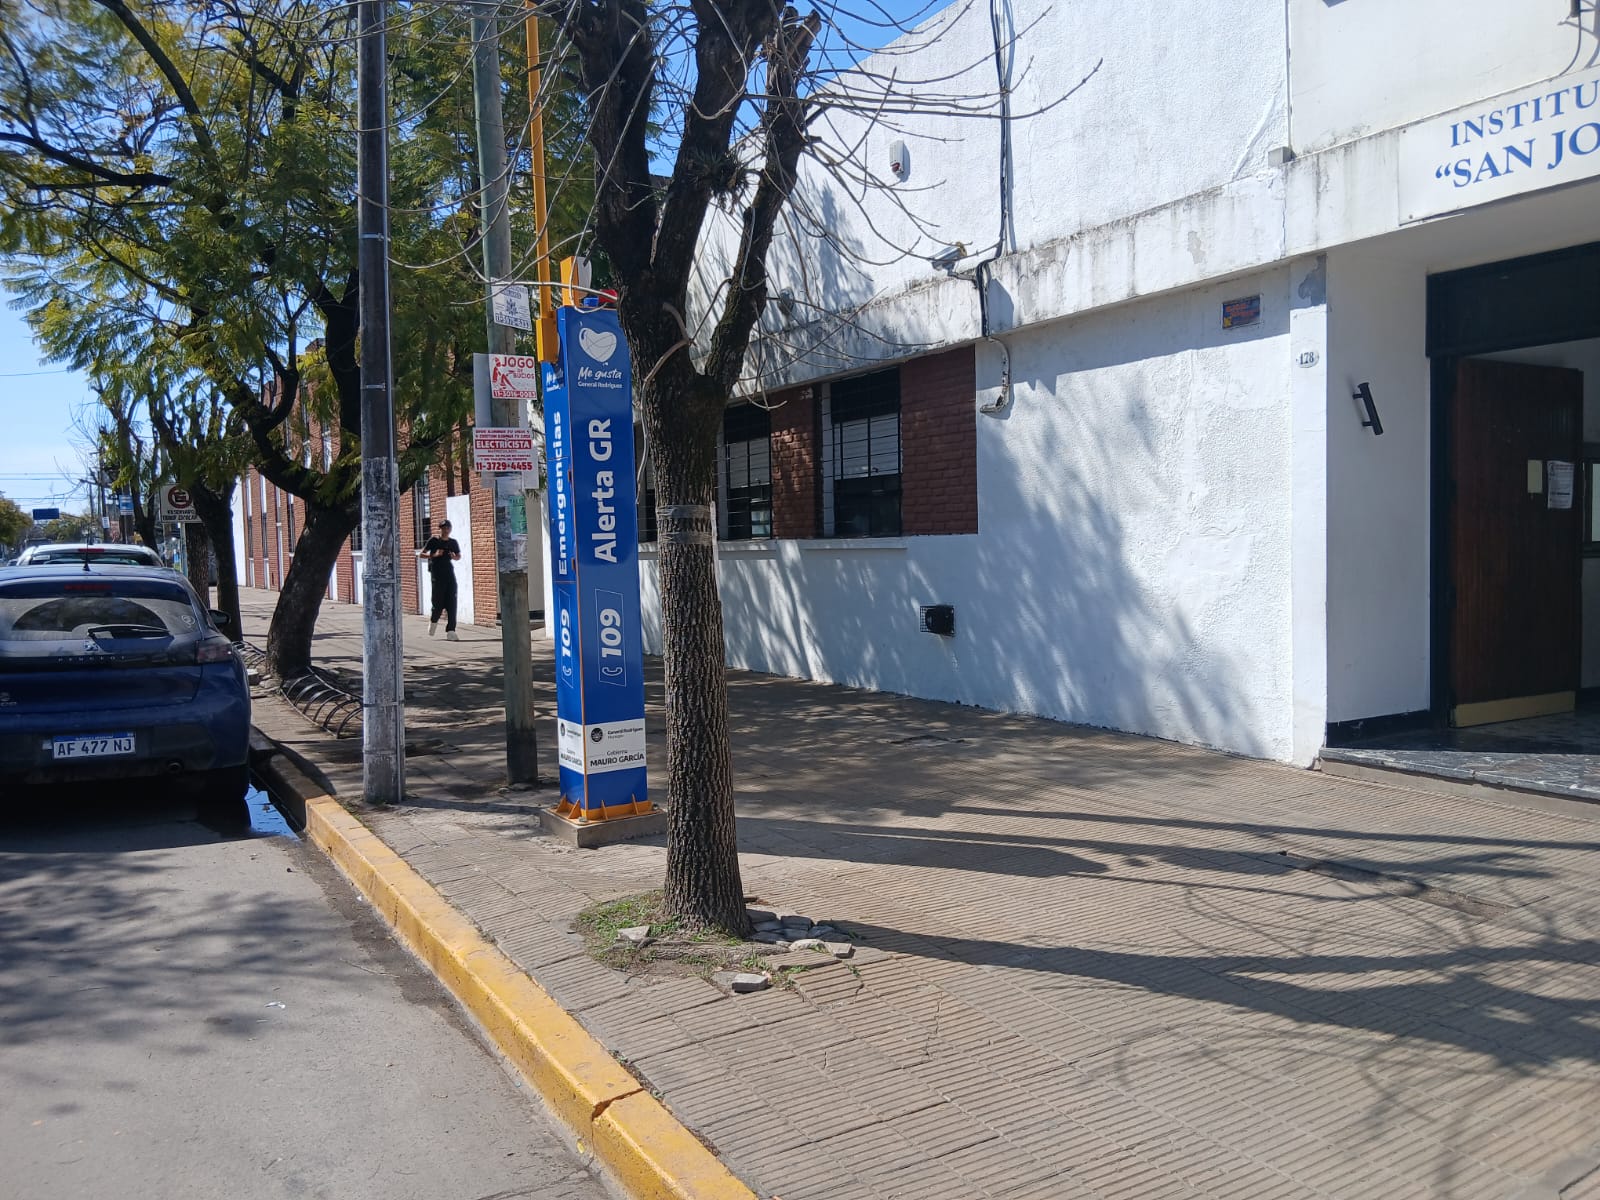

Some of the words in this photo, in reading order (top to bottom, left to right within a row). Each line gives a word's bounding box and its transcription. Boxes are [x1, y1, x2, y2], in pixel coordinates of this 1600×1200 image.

[1450, 79, 1600, 148] INSTITU
[1547, 122, 1600, 170] JO
[502, 356, 534, 369] JOGO
[578, 366, 593, 380] Me
[594, 369, 622, 380] gusta
[1300, 352, 1314, 365] 178
[476, 440, 530, 449] ELECTRICISTA
[589, 418, 613, 462] GR
[553, 411, 568, 575] Emergencias
[592, 471, 618, 564] Alerta
[561, 608, 571, 658] 109
[600, 608, 622, 658] 109
[57, 742, 75, 756] AF
[81, 740, 109, 754] 477
[113, 738, 132, 752] NJ
[590, 757, 617, 767] MAURO
[618, 752, 645, 763] GARCÍA
